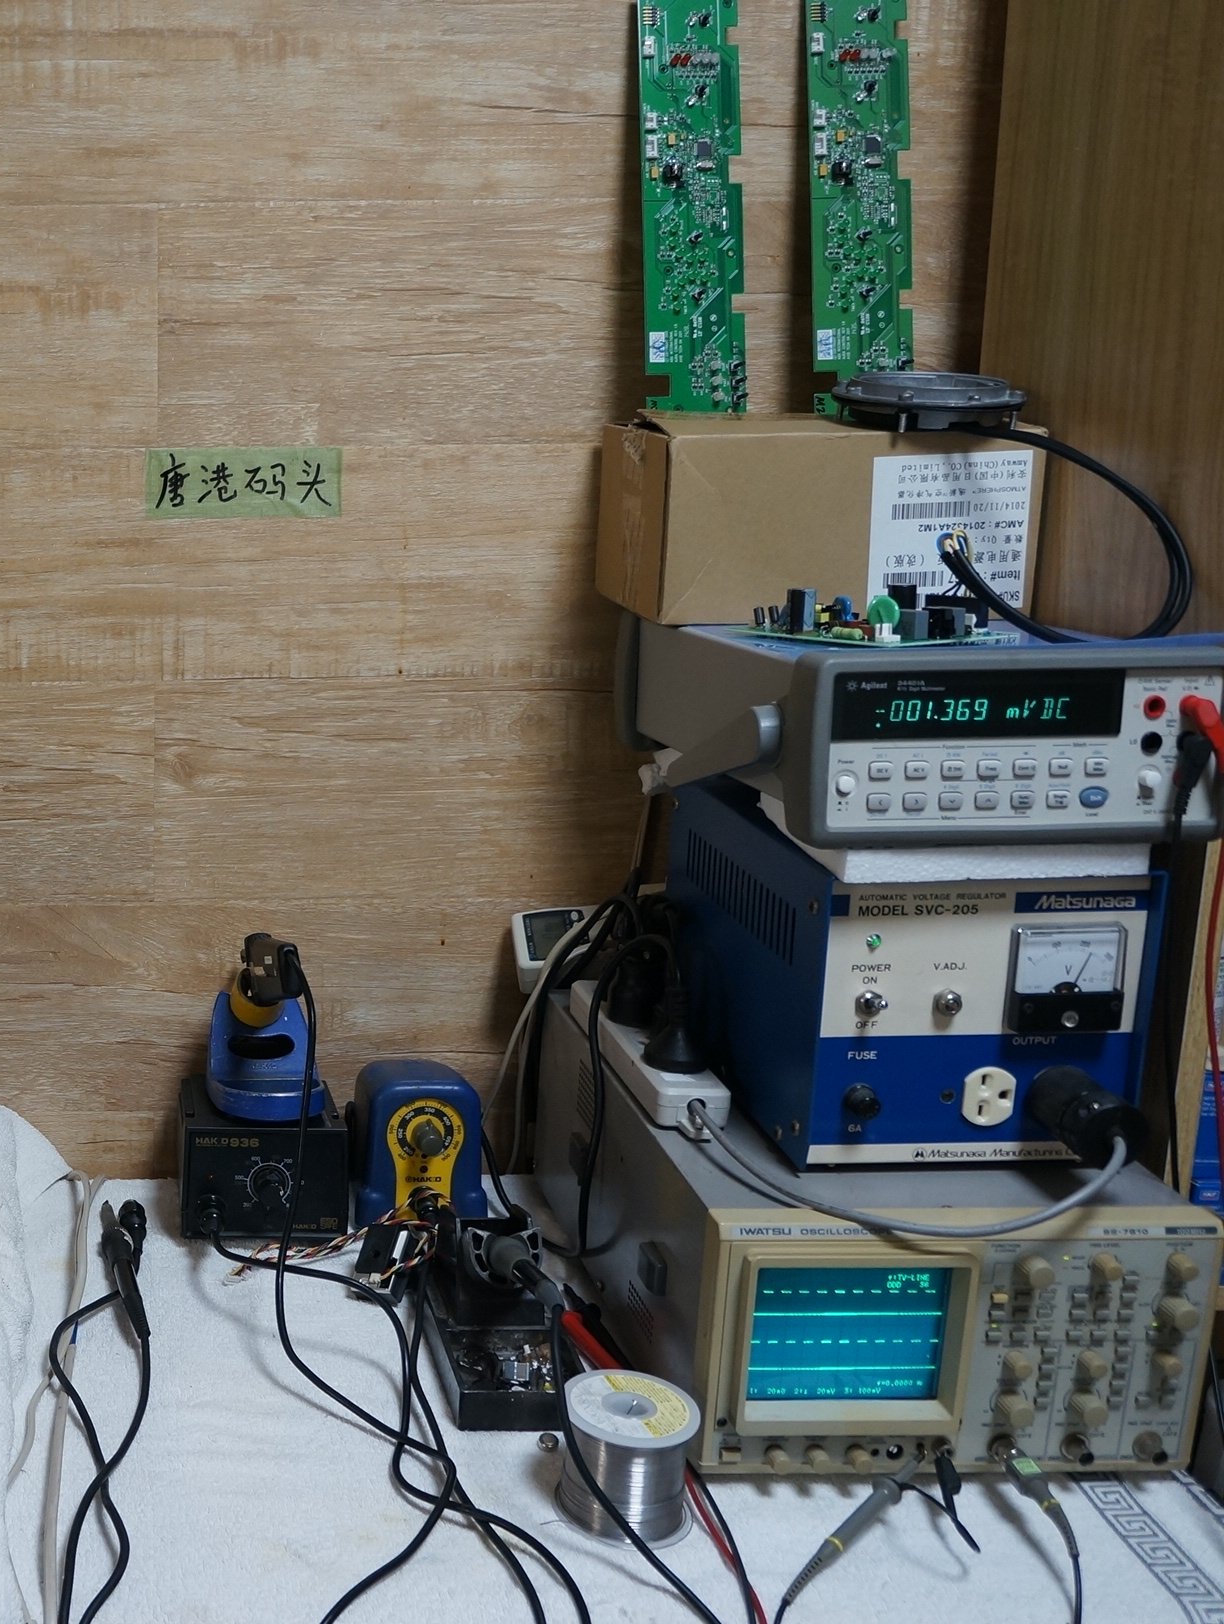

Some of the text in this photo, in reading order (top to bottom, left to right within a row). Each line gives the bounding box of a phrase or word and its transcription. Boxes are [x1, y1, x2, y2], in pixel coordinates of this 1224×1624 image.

[155, 453, 332, 509] 唐港码头
[973, 501, 1026, 512] 2014/11/20
[1034, 894, 1136, 910] Matsunaga
[858, 904, 979, 916] MODEL SVC-205
[851, 964, 891, 972] POWER
[862, 976, 878, 984] ON
[855, 1021, 878, 1029] OFF
[1012, 1036, 1057, 1046] OUTPUT
[848, 1051, 878, 1060] FUSE
[848, 1124, 862, 1133] 6A
[196, 1137, 260, 1147] HAKO 936
[928, 1150, 987, 1159] Matsunaga
[739, 1228, 792, 1236] IWATSU
